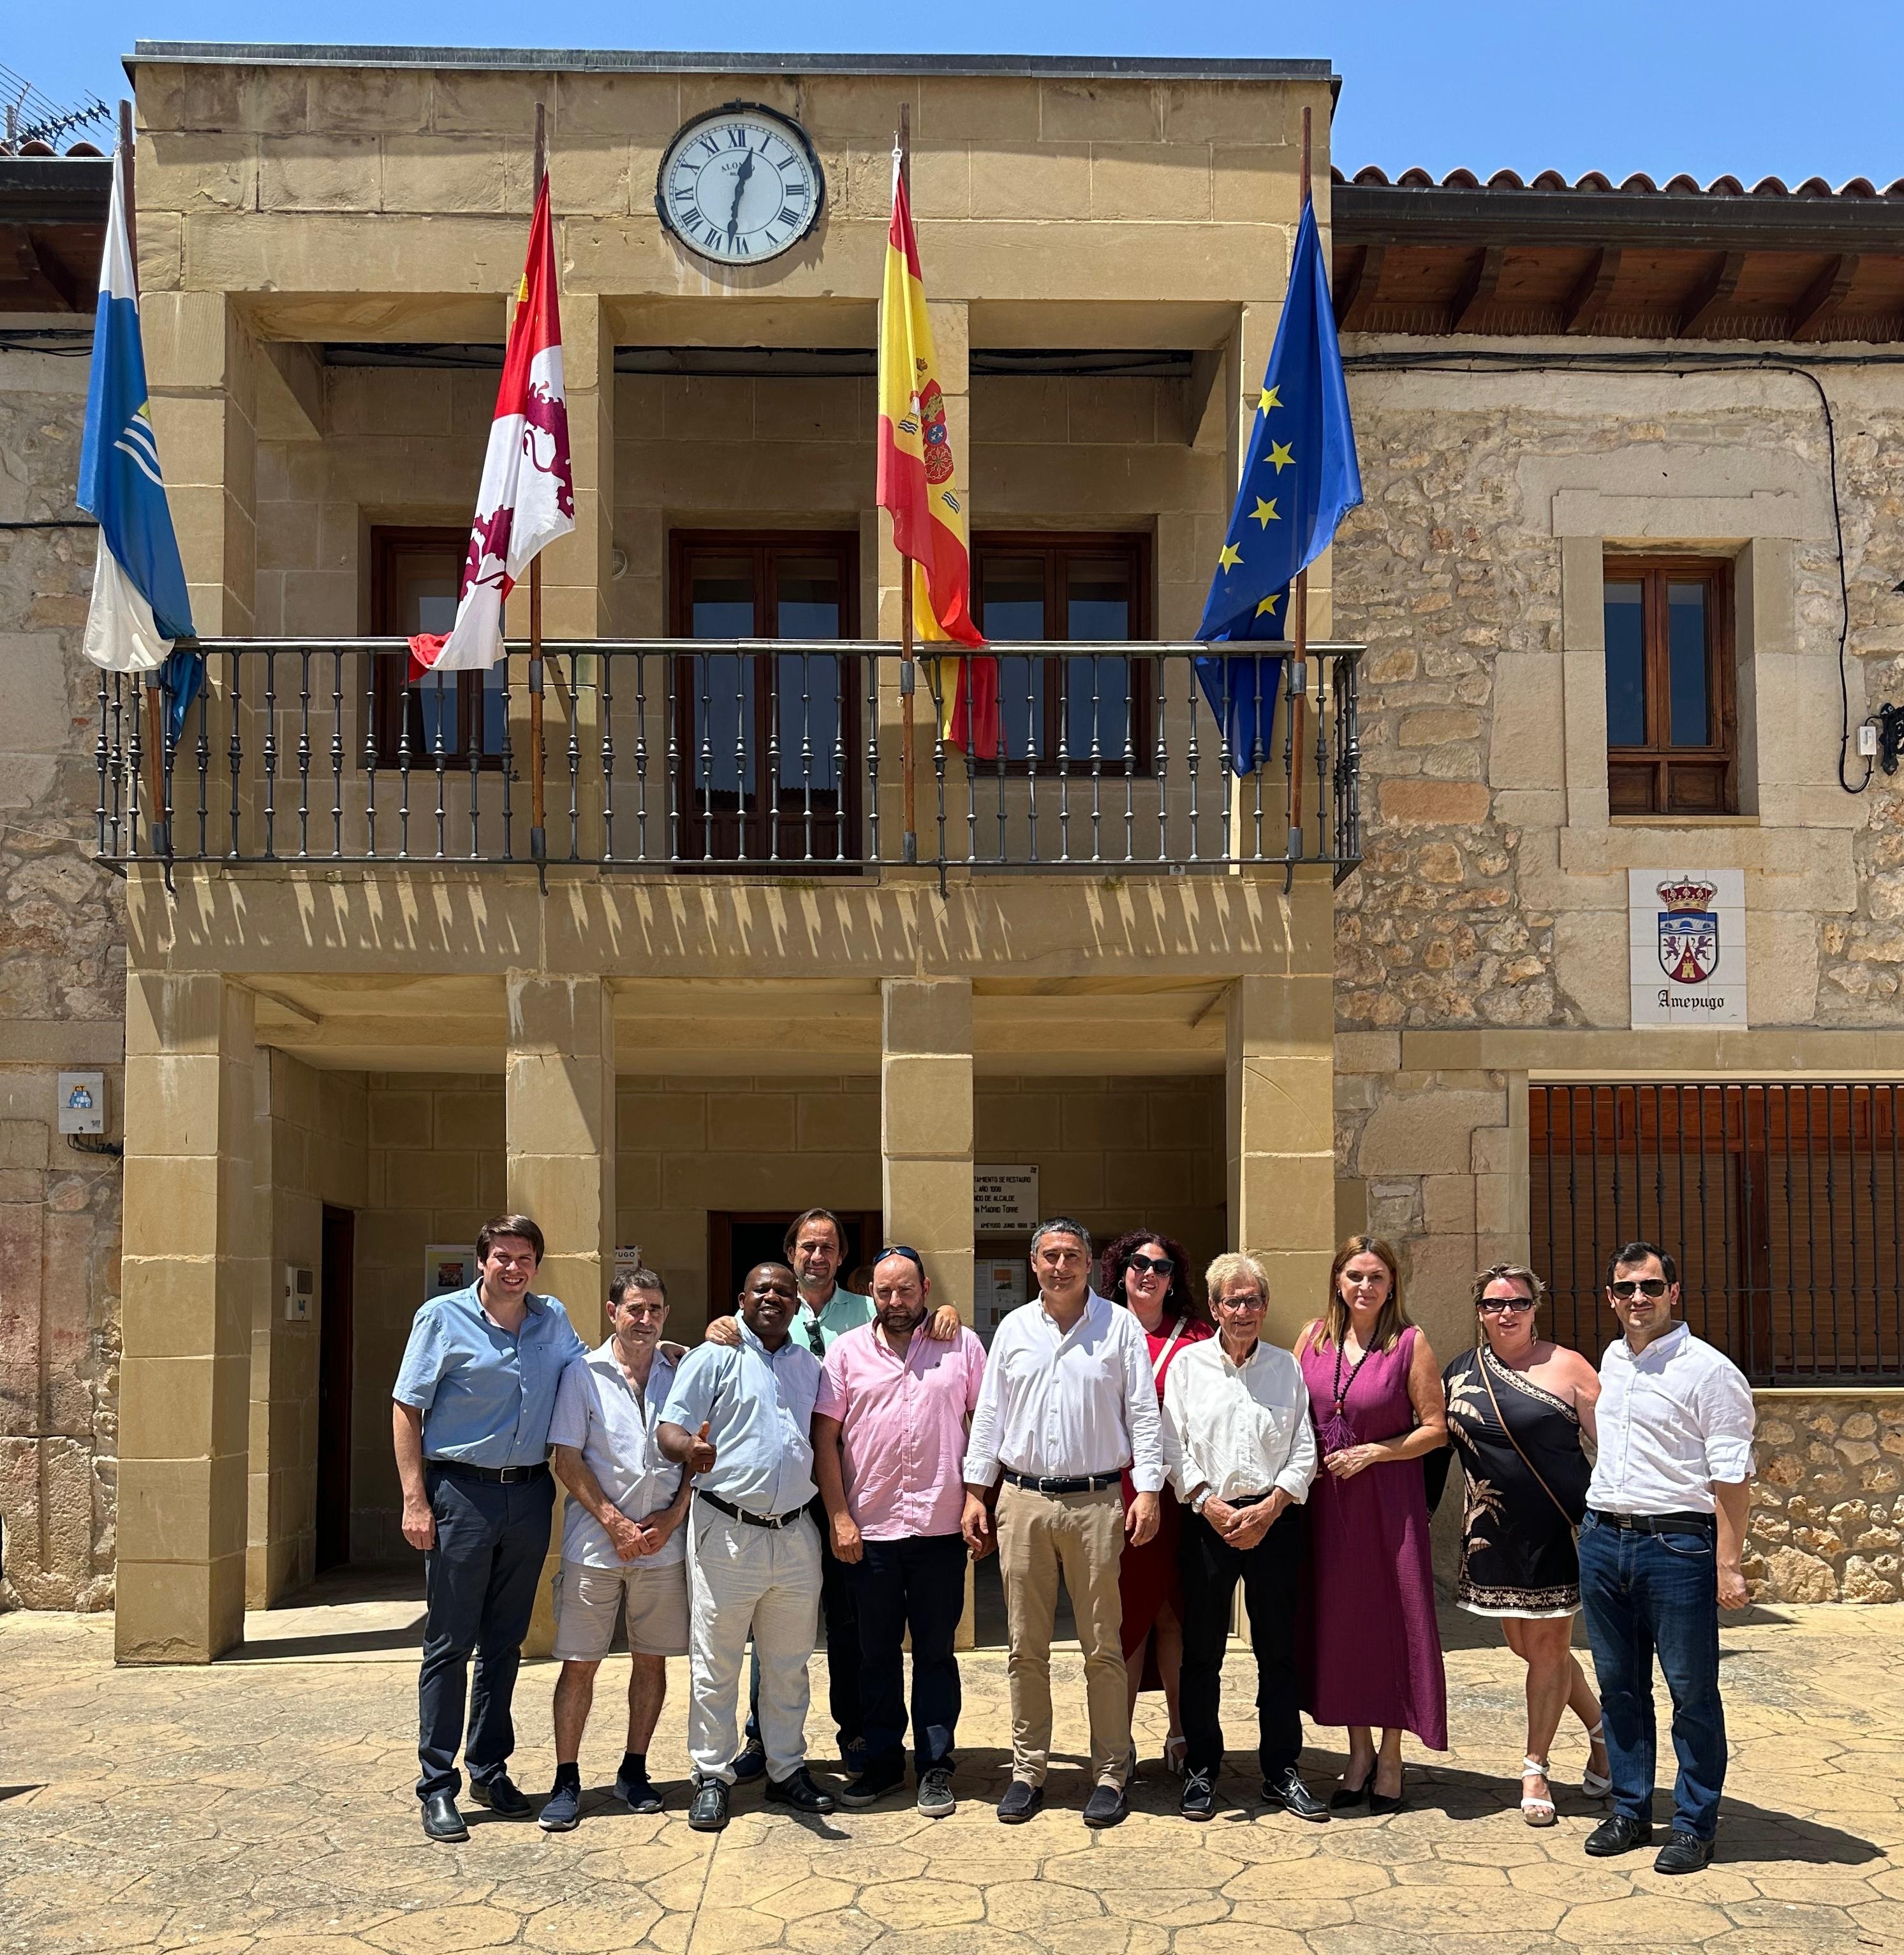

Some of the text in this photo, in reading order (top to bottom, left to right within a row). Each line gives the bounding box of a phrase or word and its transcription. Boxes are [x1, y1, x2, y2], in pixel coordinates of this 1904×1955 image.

[699, 135, 721, 158] XI
[727, 129, 747, 148] XII
[680, 158, 701, 176] X
[776, 155, 797, 172] II
[674, 186, 694, 201] IX
[785, 183, 804, 197] III
[680, 206, 704, 234] VIII
[703, 227, 723, 251] VII
[735, 236, 750, 255] VI
[764, 229, 779, 247] V
[1658, 989, 1725, 1012] Ameyugo
